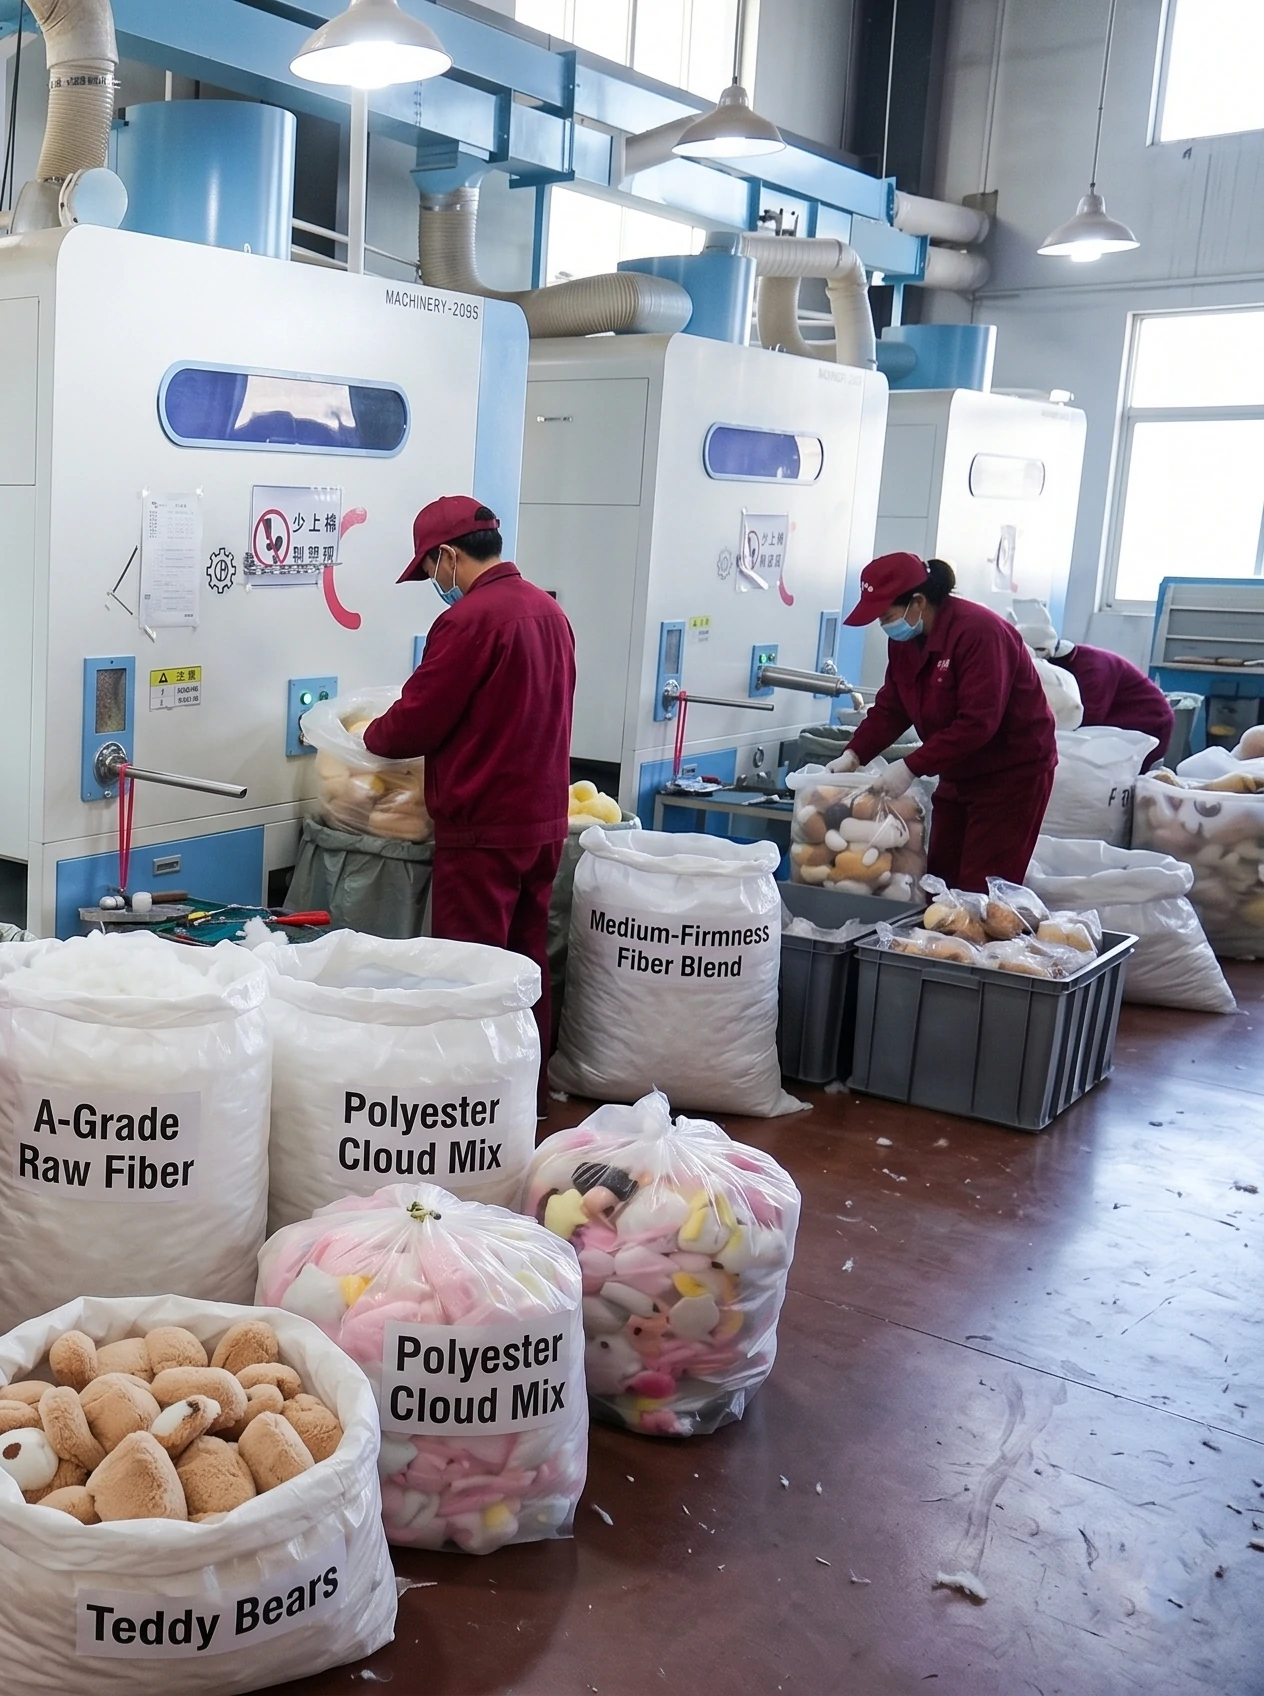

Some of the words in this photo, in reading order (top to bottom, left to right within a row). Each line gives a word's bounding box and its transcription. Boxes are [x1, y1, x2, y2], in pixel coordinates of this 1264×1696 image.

[385, 289, 479, 320] MACHINERY-209S
[590, 909, 770, 947] Medium-Firmness
[617, 946, 674, 975] Fiber
[680, 955, 742, 978] Blend
[33, 1098, 179, 1142] A-Grade
[344, 1090, 500, 1136] Polyester
[19, 1142, 91, 1187] Raw
[105, 1154, 195, 1190] Fiber
[338, 1136, 436, 1175] Cloud
[448, 1138, 503, 1174] Mix
[396, 1332, 564, 1383] Polyester
[390, 1385, 498, 1424] Cloud
[511, 1378, 566, 1420] Mix
[86, 1603, 220, 1651] Teddy
[235, 1566, 338, 1636] Bears
